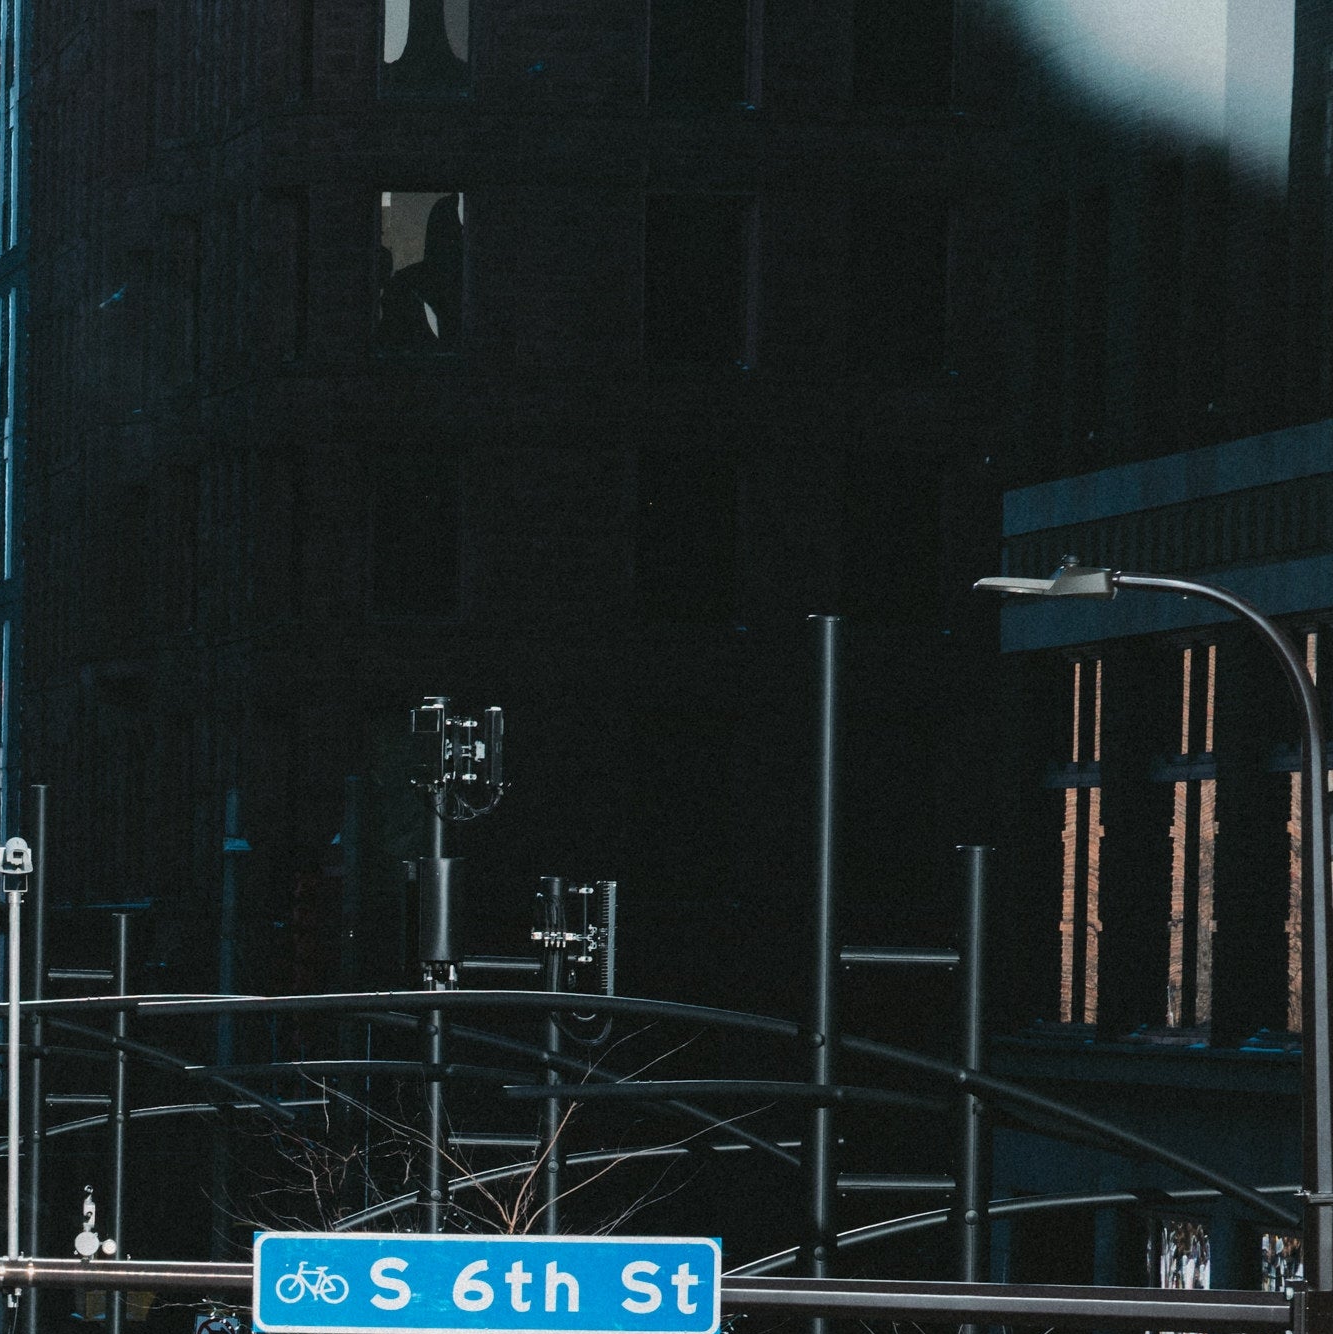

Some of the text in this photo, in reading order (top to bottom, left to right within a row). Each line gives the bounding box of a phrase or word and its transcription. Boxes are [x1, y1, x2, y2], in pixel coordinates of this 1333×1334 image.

[370, 1257, 699, 1315] S 6th St
